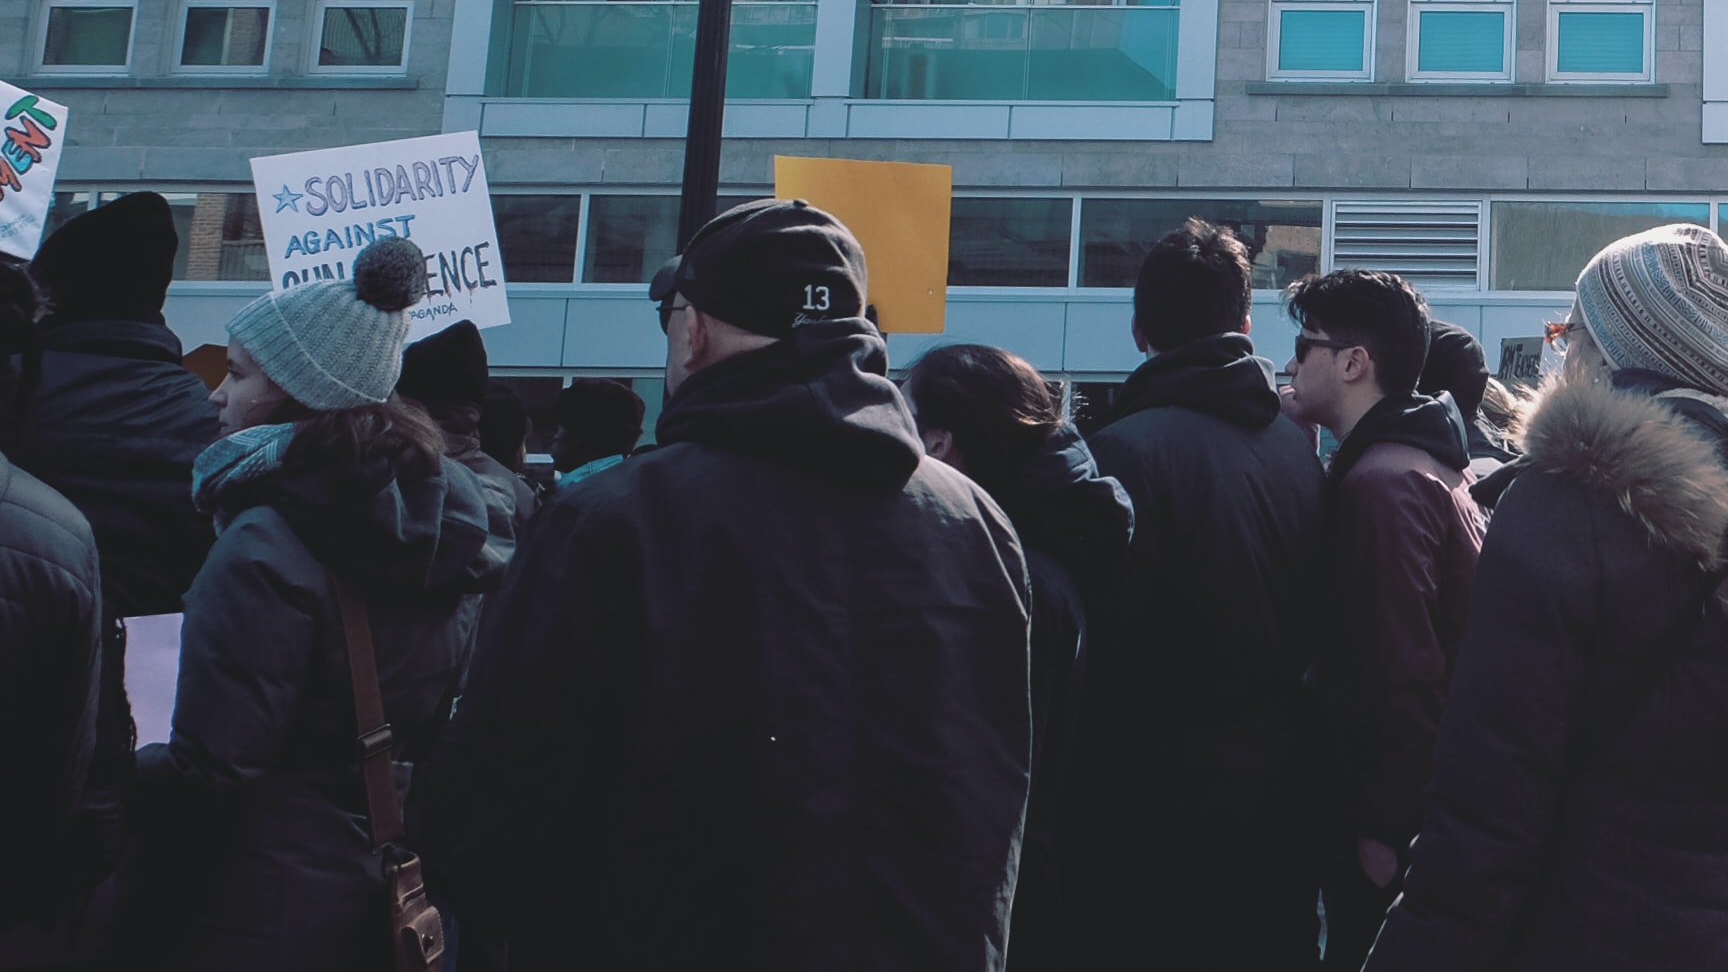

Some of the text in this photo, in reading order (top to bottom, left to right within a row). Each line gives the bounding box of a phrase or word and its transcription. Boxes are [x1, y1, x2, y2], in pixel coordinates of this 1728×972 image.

[304, 154, 480, 216] SOLIDARITY
[284, 214, 416, 259] AGAINST
[421, 241, 497, 300] ENCE
[408, 302, 458, 321] AGANDA
[802, 284, 830, 310] 13
